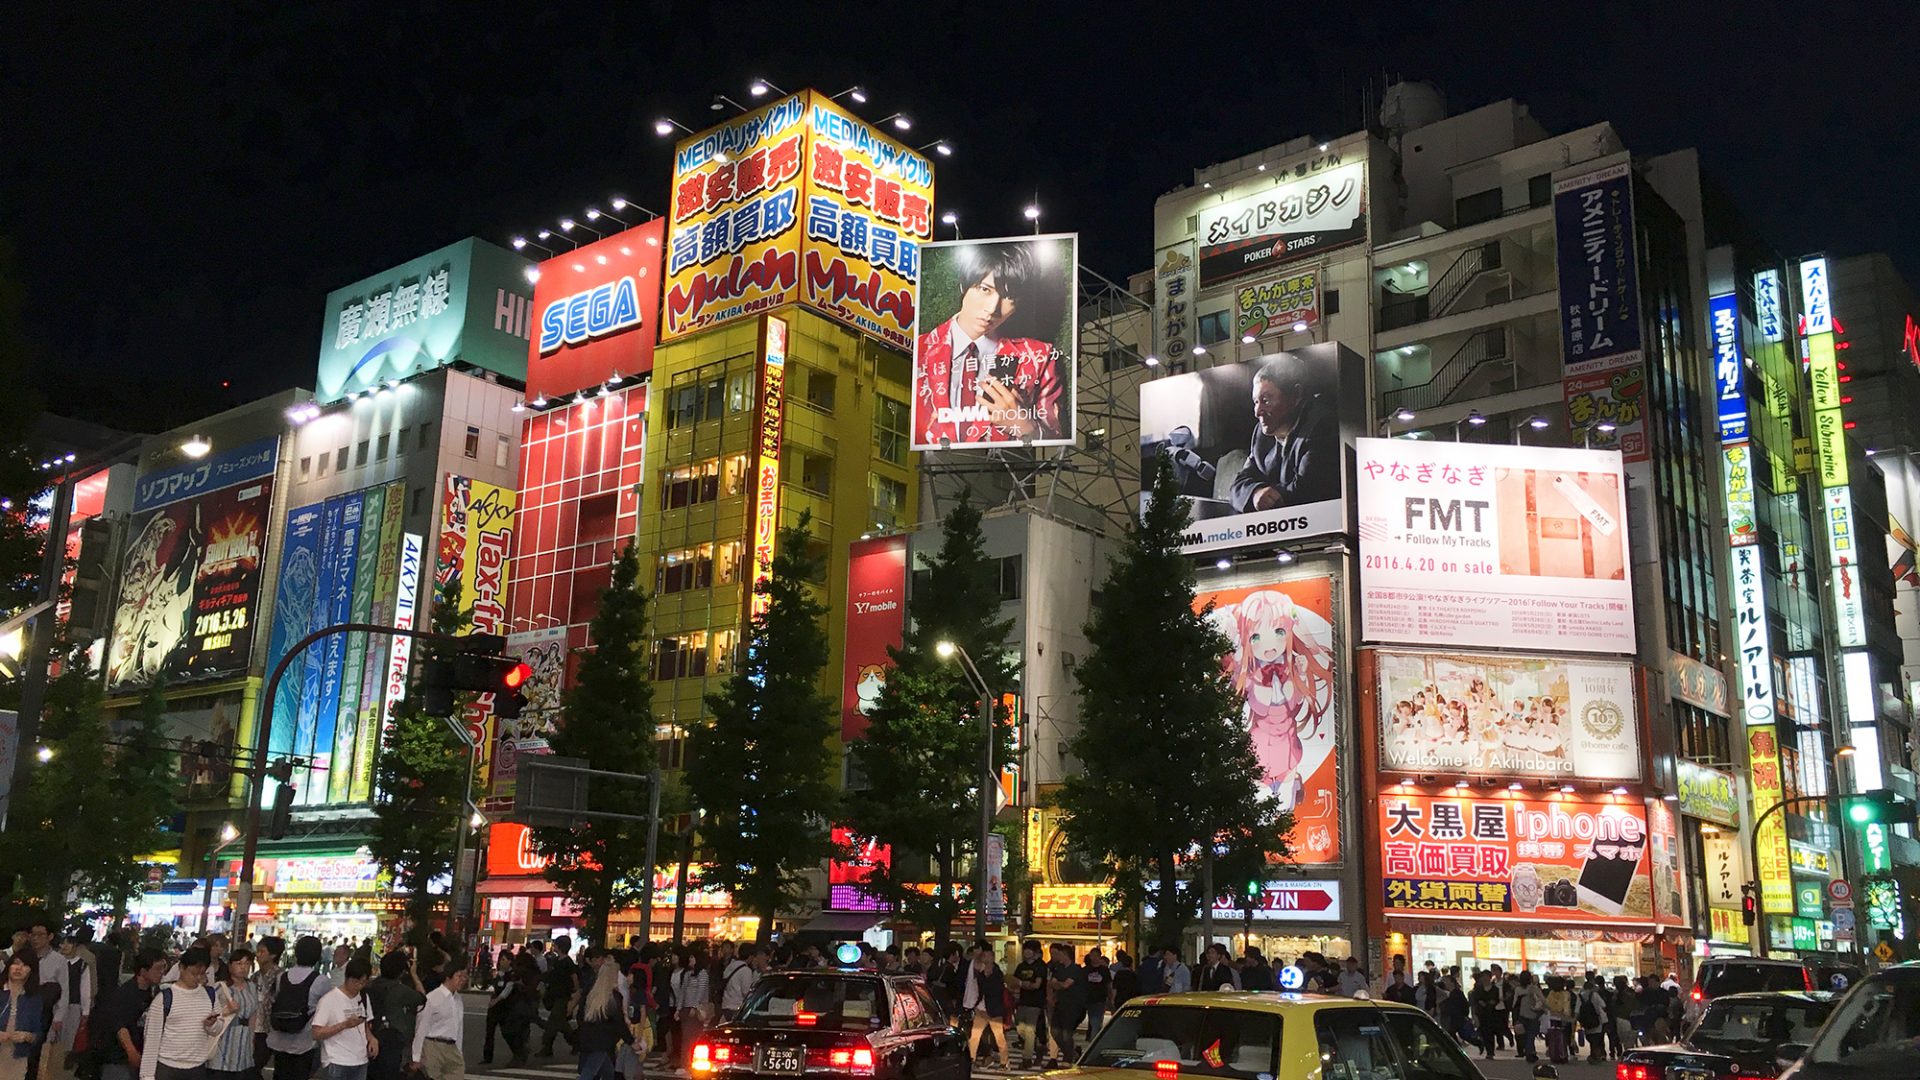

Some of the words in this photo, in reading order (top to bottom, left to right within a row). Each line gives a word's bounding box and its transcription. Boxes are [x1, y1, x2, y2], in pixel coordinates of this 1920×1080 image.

[678, 97, 802, 174] MEDIAリサイクル
[814, 104, 931, 188] MEDIAリサイクル
[675, 138, 799, 220] 激安販売
[813, 142, 928, 236] 激安販売
[1558, 179, 1591, 191] AMENITY
[1596, 167, 1625, 181] DREAM
[1208, 180, 1354, 243] メイドカジノ
[671, 190, 795, 275] 高額買取
[1244, 247, 1272, 264] POKER
[1287, 235, 1316, 251] STARS
[668, 249, 796, 332] Mulan
[1240, 275, 1314, 310] まんが喫茶
[541, 277, 640, 352] SEGA
[715, 306, 743, 322] AKIBA
[855, 316, 882, 334] AKIBA
[1166, 278, 1185, 370] まんが@
[1569, 361, 1603, 374] AMENITY
[1608, 354, 1638, 367] DREAM
[1814, 367, 1828, 405] Yellow
[938, 406, 990, 424] DMM
[991, 407, 1048, 421] mobile
[1569, 394, 1641, 424] まんが
[966, 424, 1022, 437] のスマホ
[1820, 415, 1836, 480] Submarine
[142, 463, 212, 502] ソフマップ
[1364, 460, 1488, 487] やなぎなぎ
[1727, 447, 1746, 492] まんが
[1180, 528, 1243, 547] MM.make
[1246, 517, 1308, 538] ROBOTS
[1405, 497, 1489, 533] FMT
[1590, 509, 1610, 528] FMT
[1406, 534, 1440, 545] Follow
[1442, 535, 1457, 547] My
[1459, 536, 1491, 548] Tracks
[403, 538, 419, 597] AKKY
[1366, 555, 1435, 572] 2016.4.20
[1441, 562, 1457, 573] on
[1464, 561, 1493, 574] sale
[1388, 750, 1463, 768] Welcome
[1468, 752, 1483, 768] to
[1488, 751, 1574, 773] Akihabara
[1750, 730, 1780, 791] 免税
[1388, 803, 1507, 840] 大黒屋
[1514, 803, 1641, 842] iphone
[1385, 842, 1510, 877] 高価買取
[1516, 842, 1566, 859] 携帯
[1573, 842, 1642, 860] スマホ
[1774, 835, 1790, 880] FREE
[1388, 881, 1508, 902] 外貨両替
[1718, 851, 1733, 900] ルノアール
[1834, 885, 1846, 893] 40
[1270, 891, 1299, 909] ZIN
[1393, 901, 1504, 912] EXCHANGE
[1121, 1009, 1142, 1018] 1512
